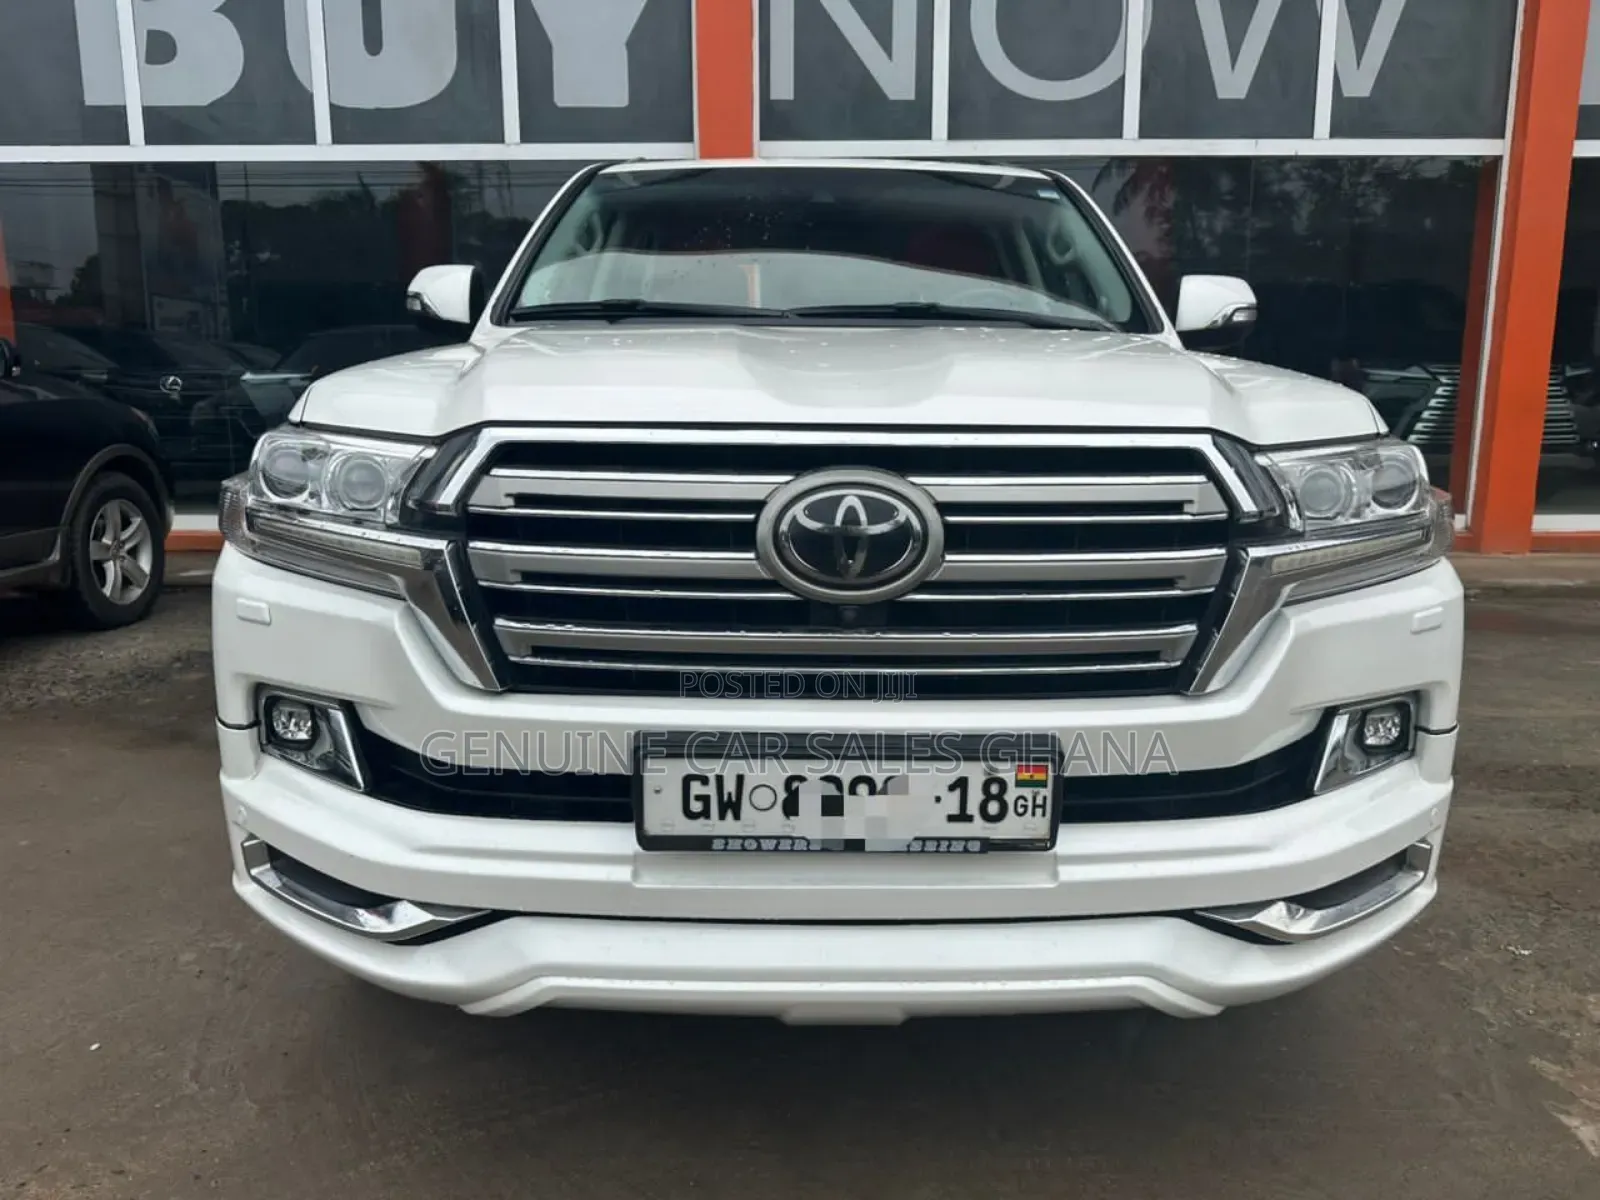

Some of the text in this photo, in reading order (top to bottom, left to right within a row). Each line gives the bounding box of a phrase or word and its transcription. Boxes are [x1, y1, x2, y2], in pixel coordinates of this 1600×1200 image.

[74, 0, 1407, 109] BUY NOW
[1013, 794, 1047, 818] GH
